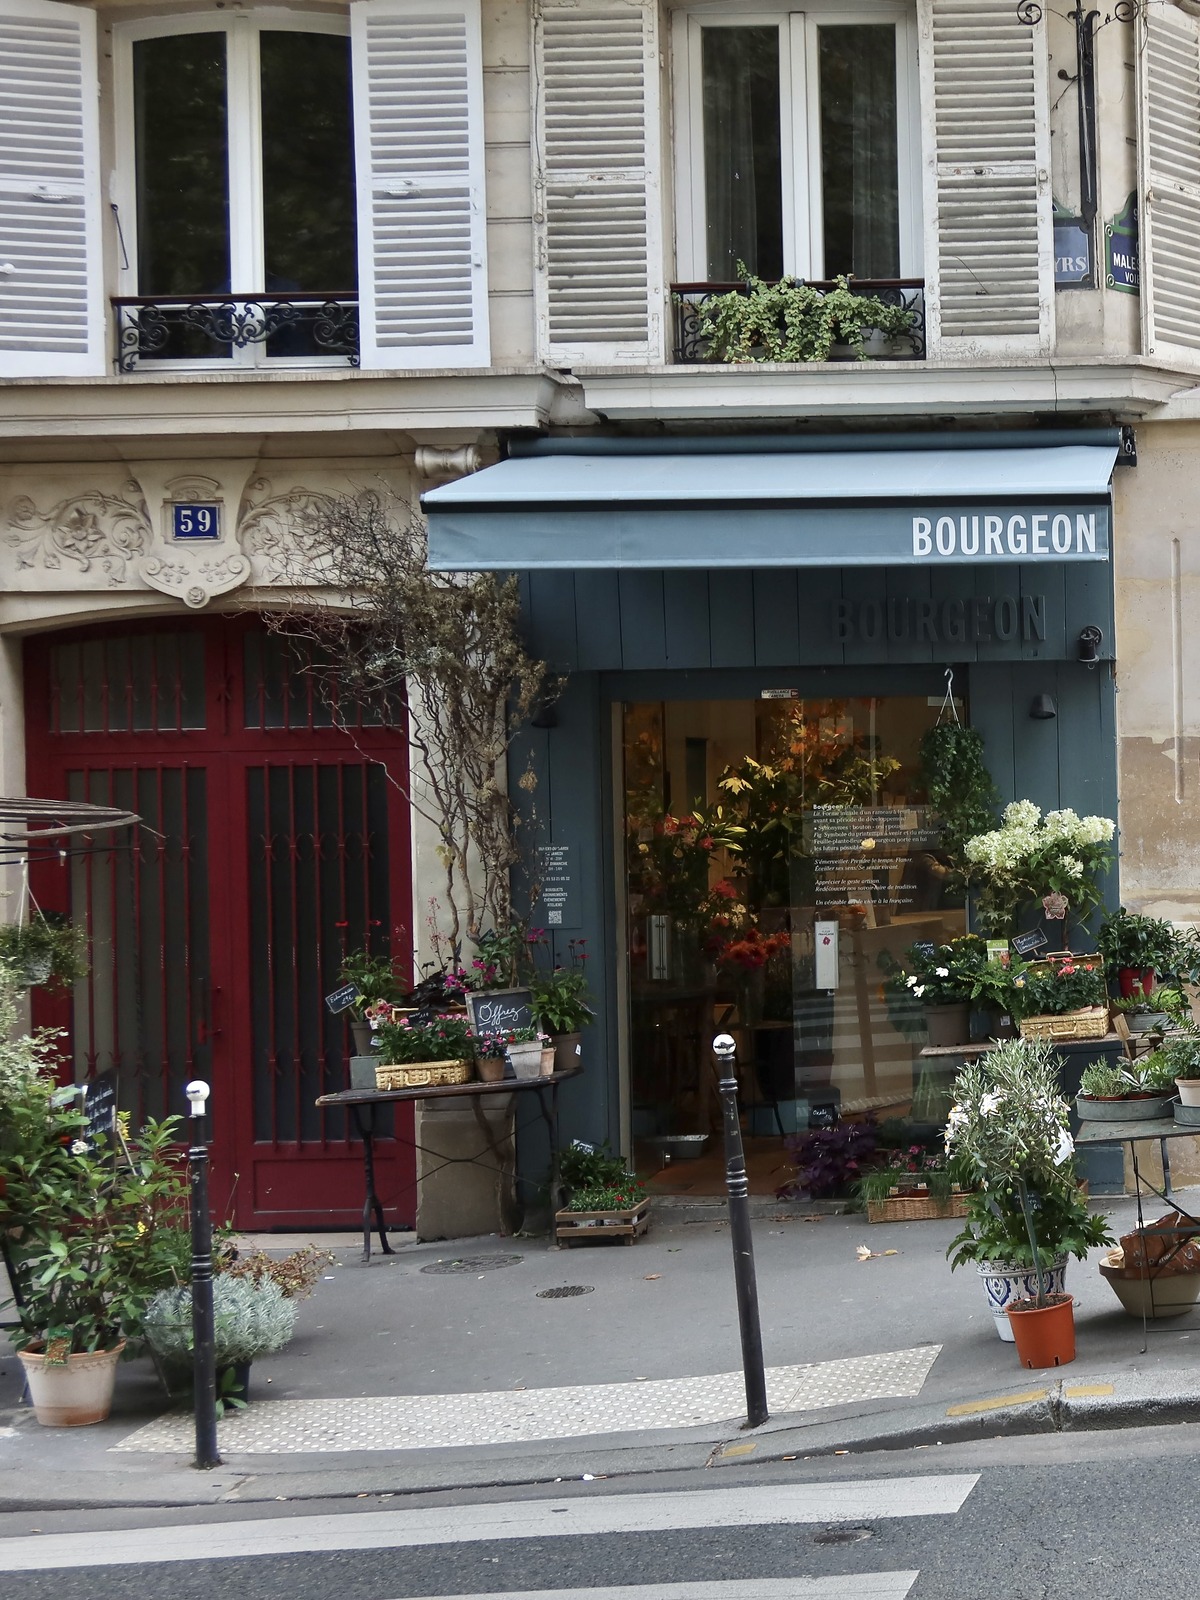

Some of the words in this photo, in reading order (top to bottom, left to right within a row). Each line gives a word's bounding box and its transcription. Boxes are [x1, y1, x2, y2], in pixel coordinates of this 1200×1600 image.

[180, 509, 211, 533] 59
[912, 513, 1096, 556] BOURGEON
[831, 594, 1047, 644] BOURGEON
